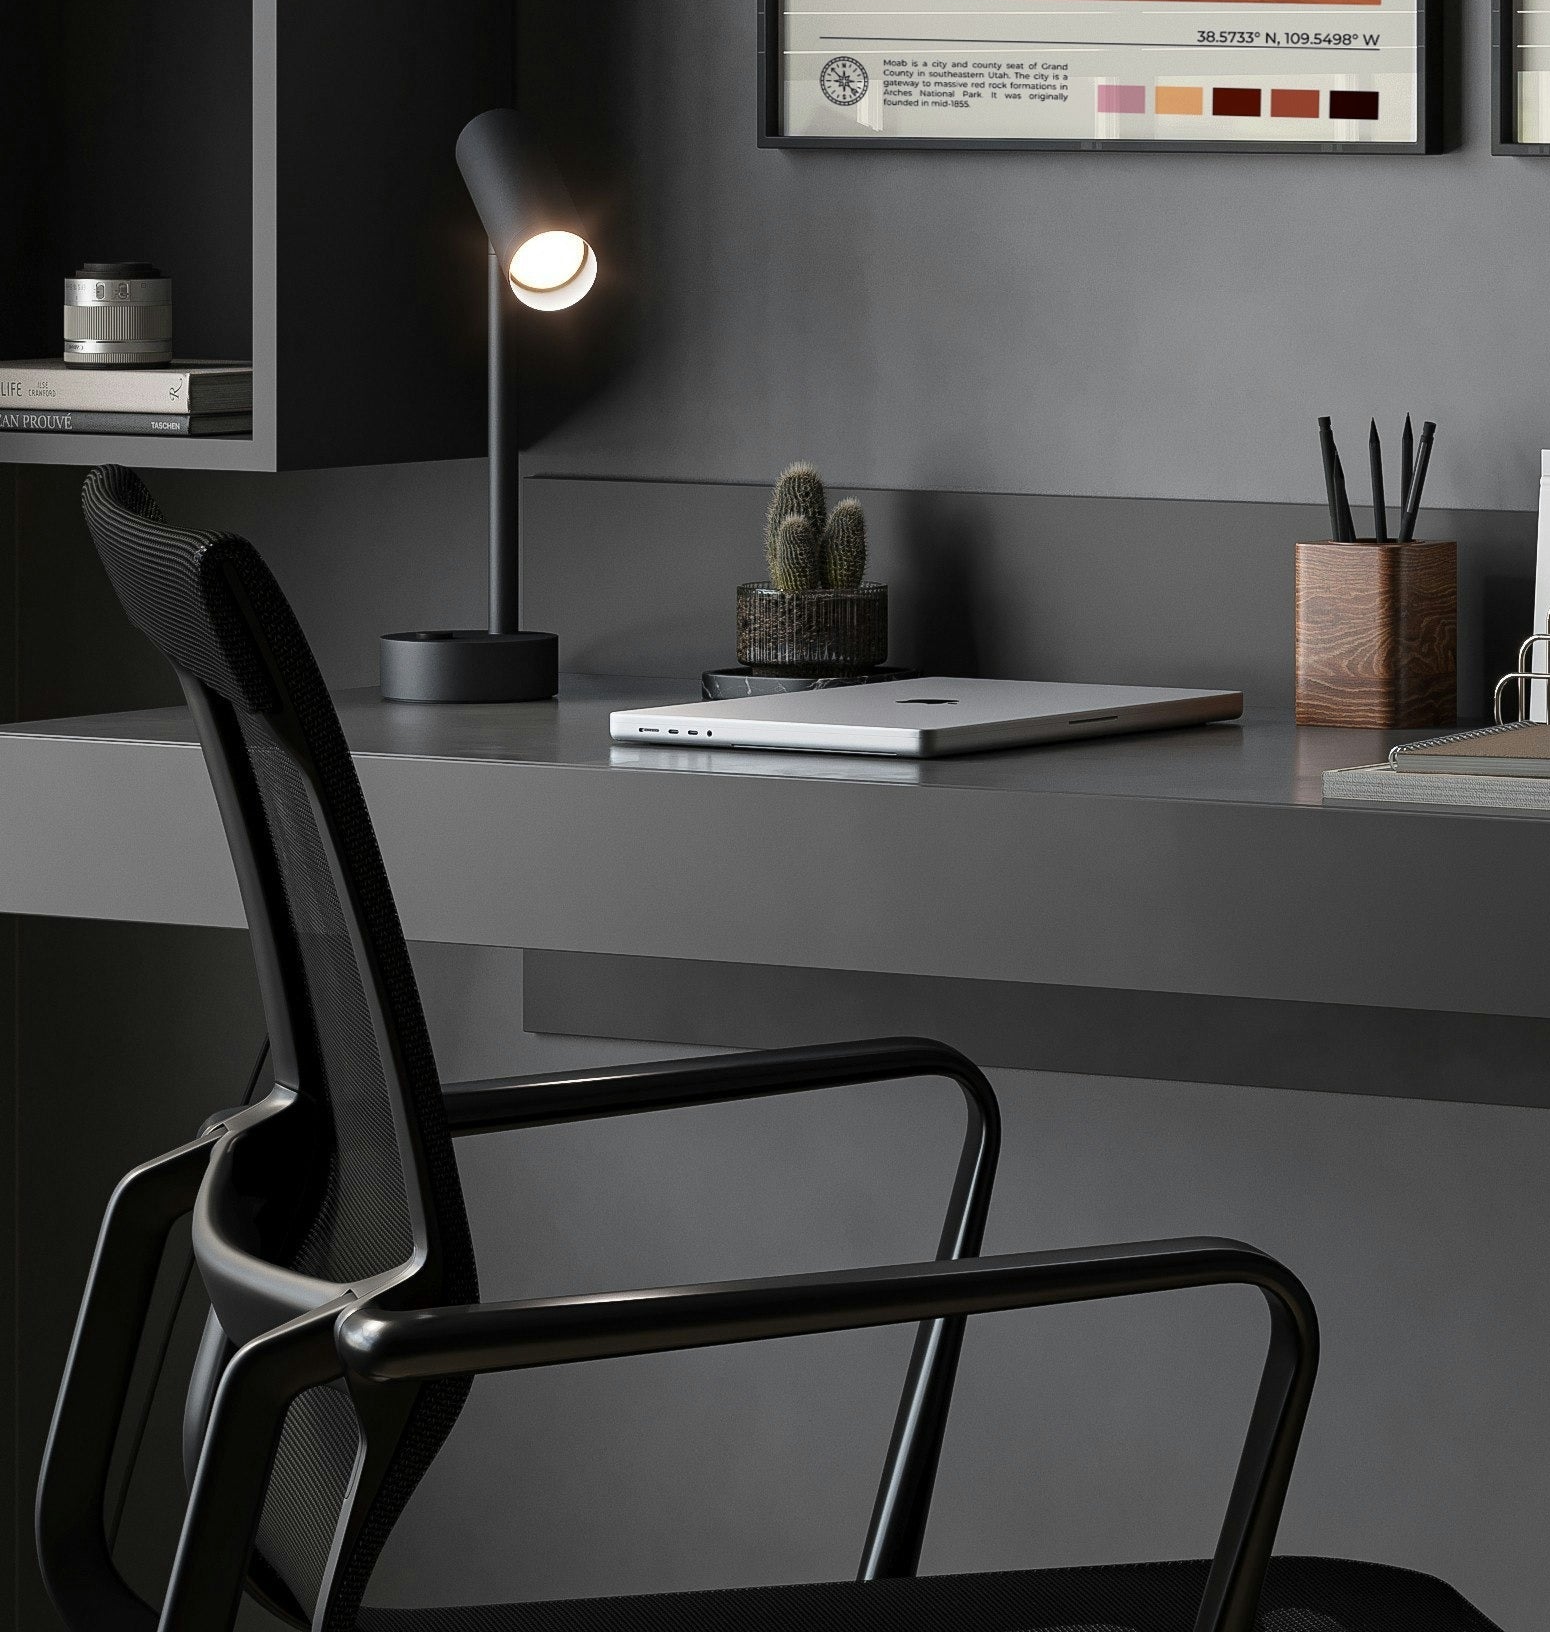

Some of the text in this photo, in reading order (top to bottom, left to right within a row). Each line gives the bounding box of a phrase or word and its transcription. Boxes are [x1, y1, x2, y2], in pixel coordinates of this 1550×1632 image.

[1197, 30, 1380, 47] 38.5733° N, 109.5498° W
[883, 59, 908, 67] Moab
[932, 60, 947, 69] city
[972, 62, 1002, 71] county
[1028, 62, 1037, 70] of
[1041, 62, 1068, 71] Grand
[883, 69, 914, 79] County
[917, 69, 926, 77] in
[928, 70, 984, 78] southeastern
[988, 71, 1011, 79] Utah.
[1014, 72, 1031, 80] The
[1033, 72, 1049, 82] city
[883, 79, 920, 88] gateway
[1010, 81, 1057, 90] formations
[883, 98, 919, 106] founded
[919, 90, 955, 98] National
[1028, 93, 1068, 102] originally
[1, 382, 22, 397] LIFE
[23, 413, 73, 429] PROUVÉ
[151, 421, 181, 430] TASCHEN
